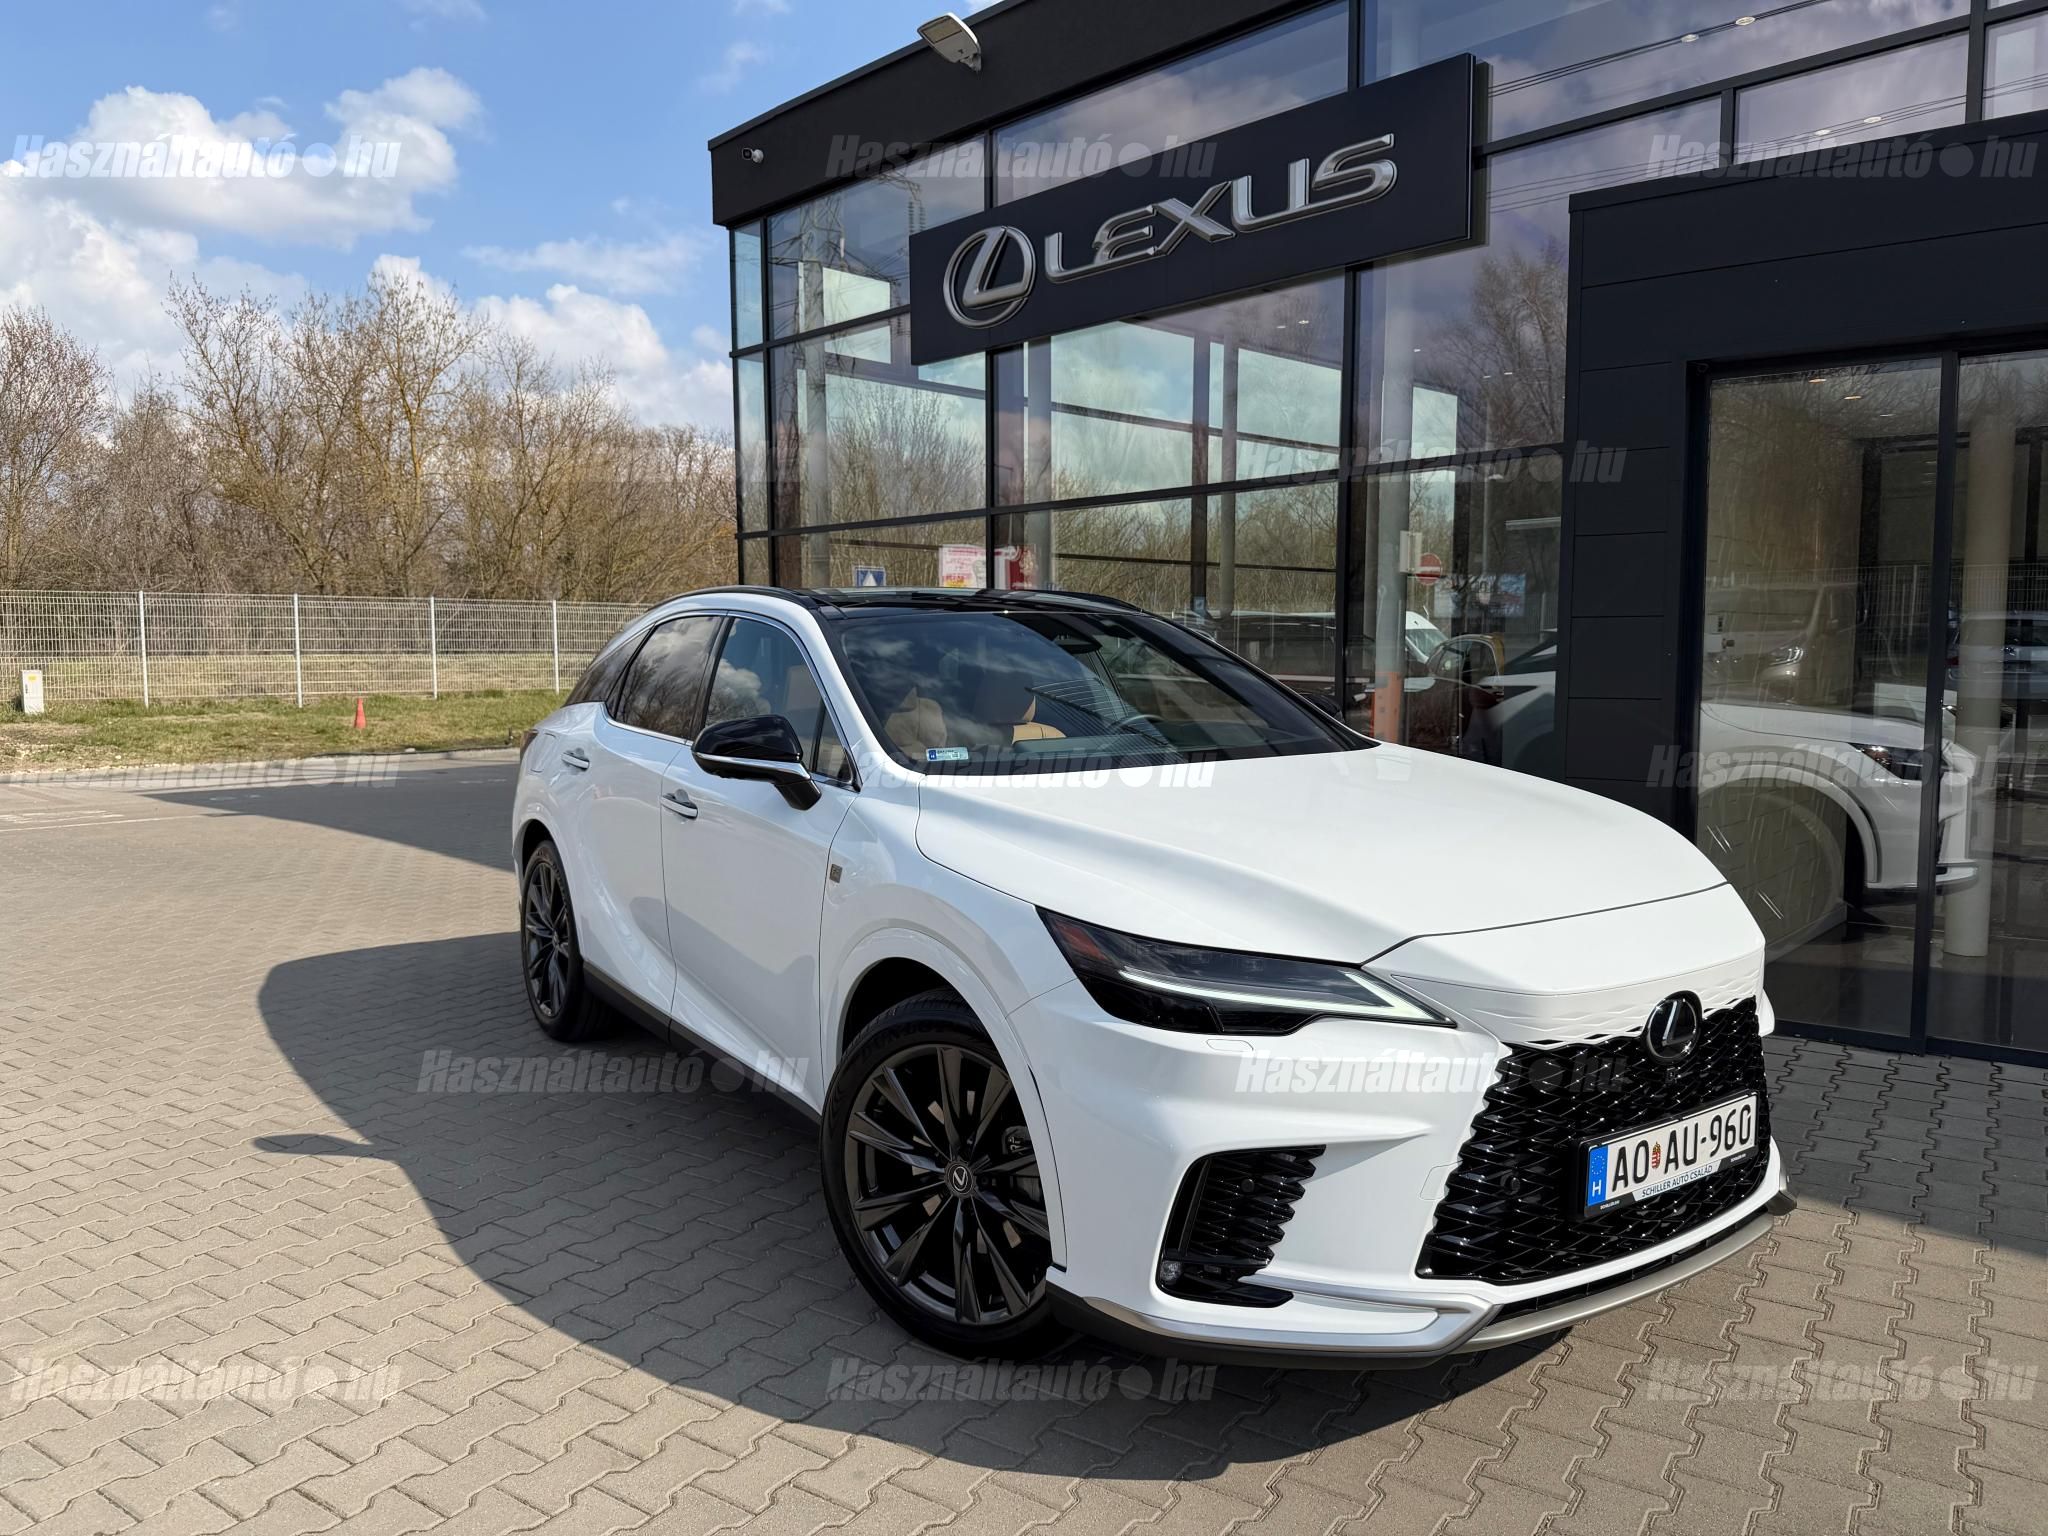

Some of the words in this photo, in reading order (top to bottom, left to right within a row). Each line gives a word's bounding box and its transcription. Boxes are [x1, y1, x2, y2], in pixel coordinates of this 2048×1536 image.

[1045, 133, 1398, 283] LEXUS
[1612, 1139, 1650, 1192] AO
[1664, 1103, 1752, 1174] AU-960
[1592, 1179, 1602, 1197] H
[1641, 1179, 1671, 1198] SCHILLER
